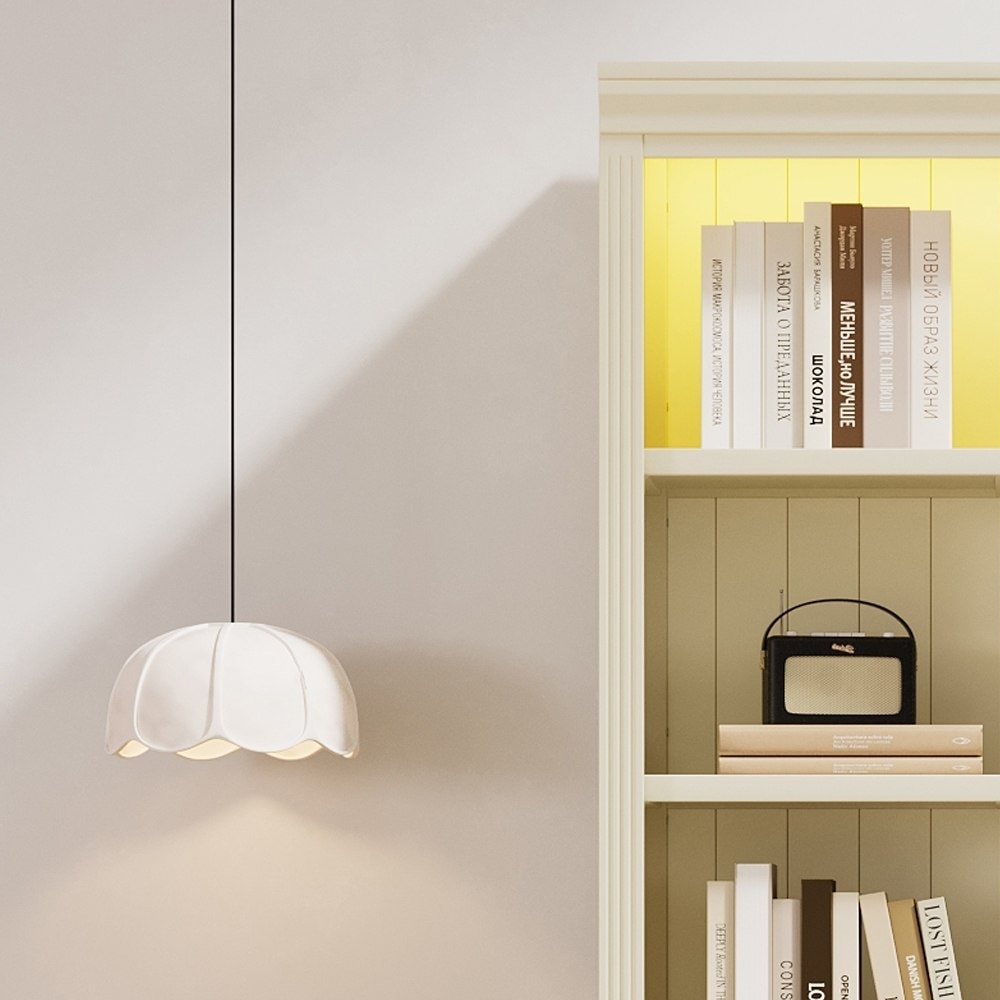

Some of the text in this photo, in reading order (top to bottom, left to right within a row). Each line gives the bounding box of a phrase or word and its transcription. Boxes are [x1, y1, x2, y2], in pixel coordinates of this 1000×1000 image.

[813, 226, 822, 310] АНАСТАСИЯ БАРАШКОВА
[711, 259, 722, 425] ИСТОРИЯ МАКРОКОСМОСА, ИСТОРИЯ ЧЕЛОВЕКА
[774, 261, 791, 422] ЗАБОТА О ПРЕДАННЫХ
[879, 305, 894, 355] РАЗВИТИЕ
[923, 241, 940, 419] НОВЫЙ ОБРАЗ ЖИЗНИ
[810, 355, 824, 425] ШОКОЛАД
[839, 382, 855, 427] ЛУЧШЕ
[716, 923, 726, 953] DEEPLY
[905, 955, 920, 989] DANISH
[924, 905, 954, 998] LOST FISH
[716, 979, 726, 987] IN
